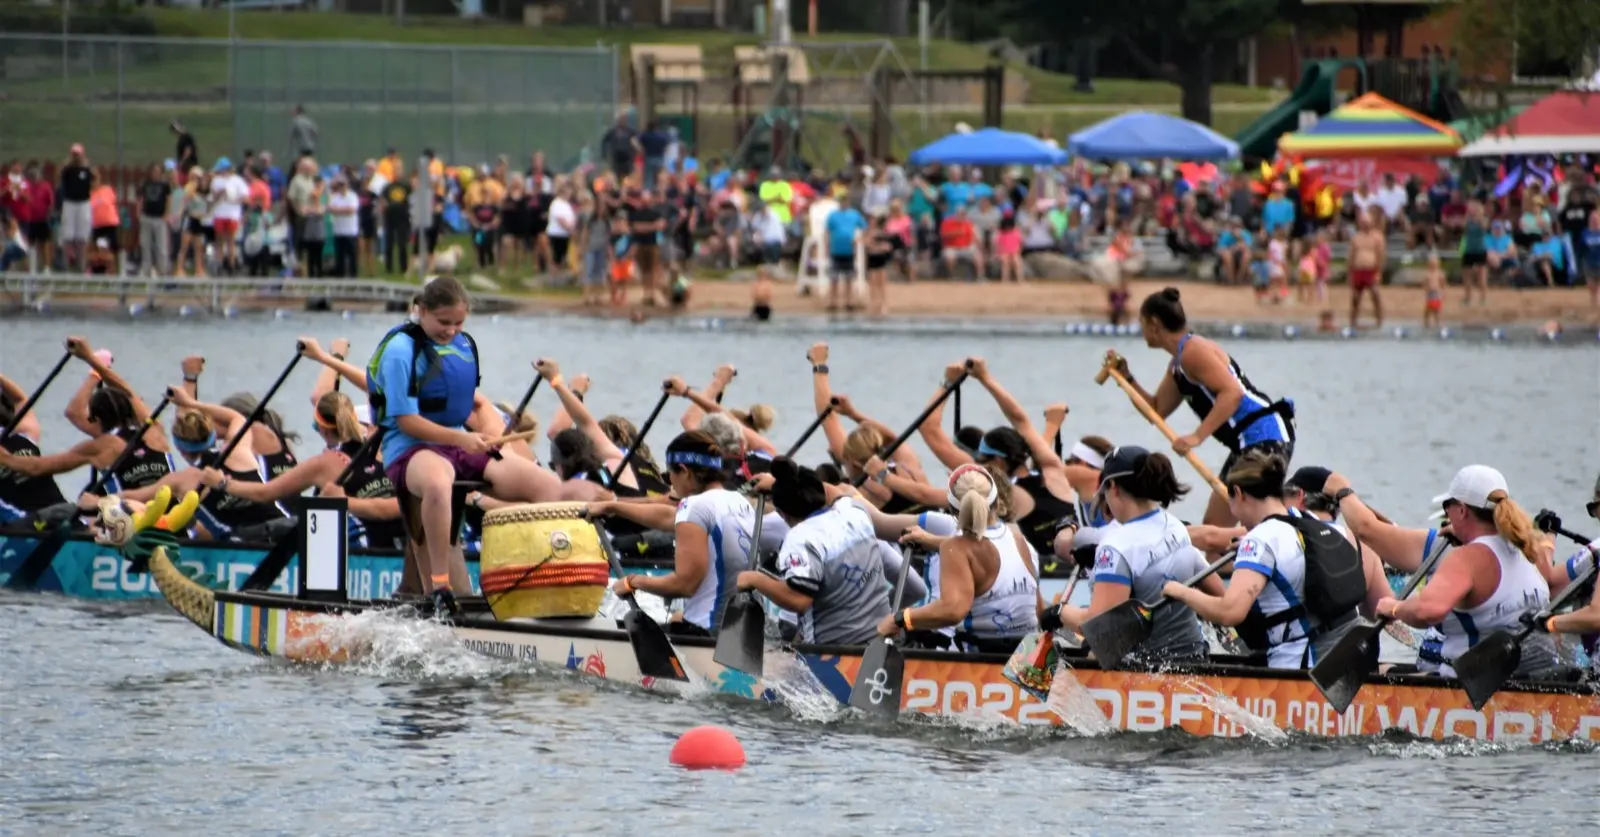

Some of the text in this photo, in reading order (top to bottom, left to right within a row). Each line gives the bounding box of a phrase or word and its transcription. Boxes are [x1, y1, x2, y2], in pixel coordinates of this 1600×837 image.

[310, 513, 317, 534] 3
[519, 643, 538, 661] USA
[1287, 700, 1365, 737] CREW
